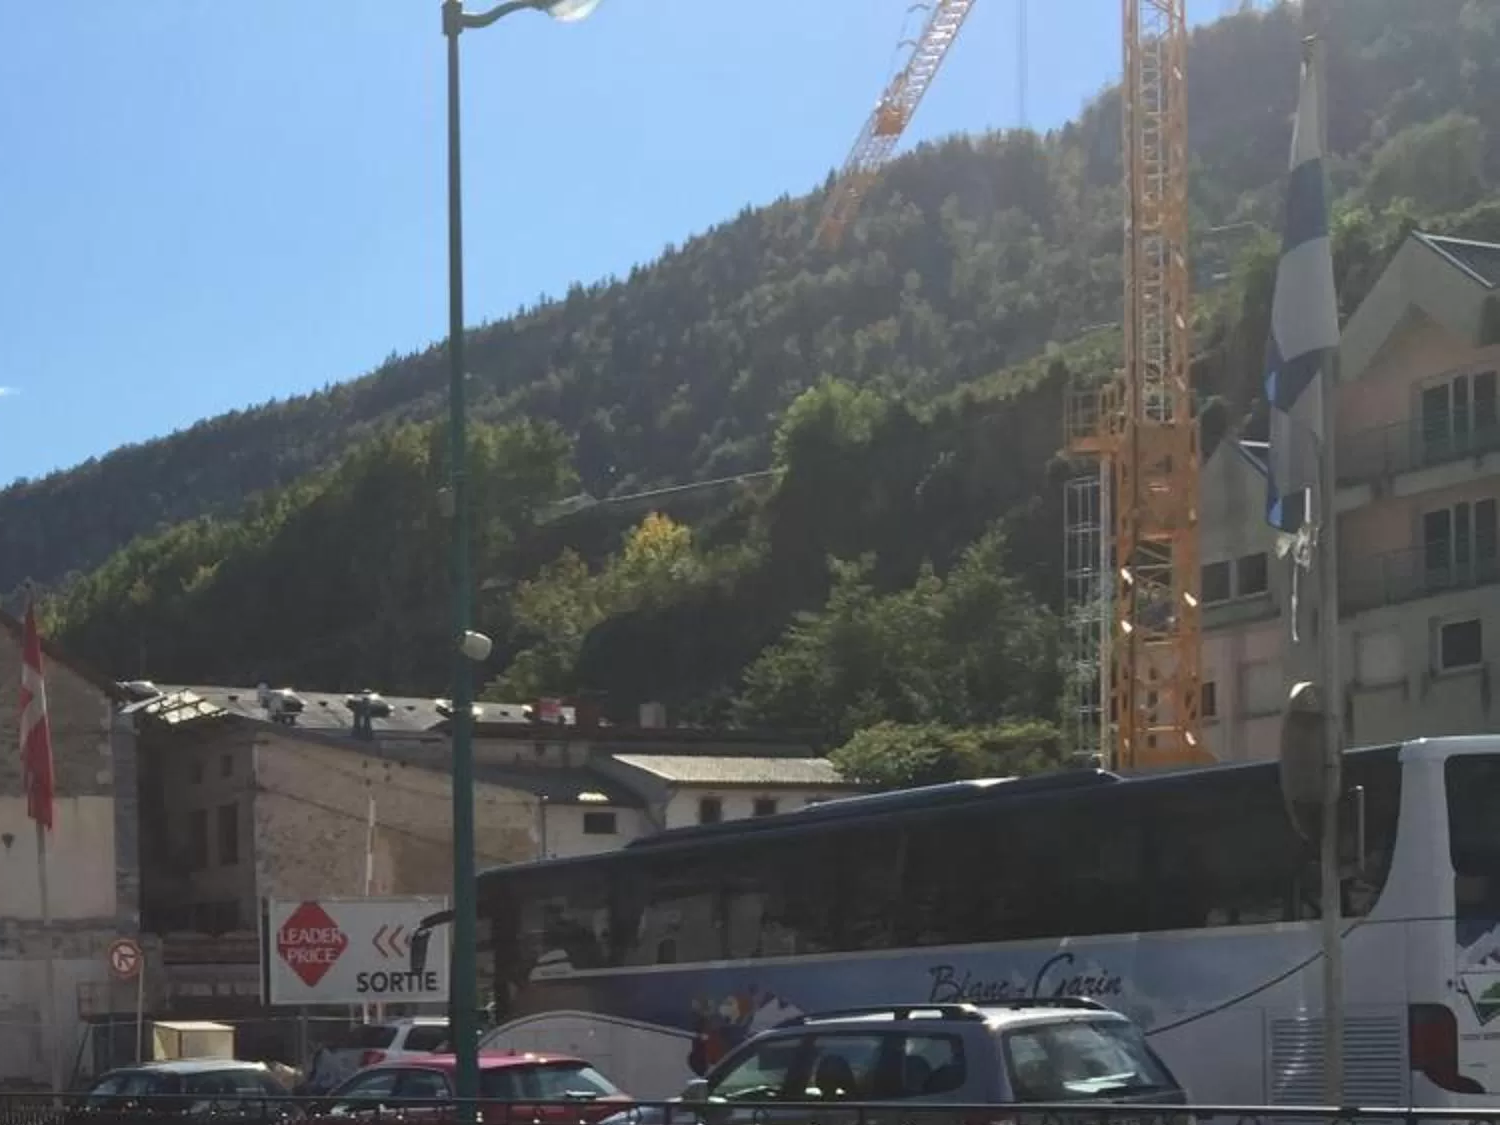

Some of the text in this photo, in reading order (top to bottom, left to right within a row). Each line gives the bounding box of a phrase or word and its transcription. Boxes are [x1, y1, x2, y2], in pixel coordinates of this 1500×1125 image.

[279, 928, 343, 945] LEADER
[286, 948, 338, 963] PRICE
[356, 972, 437, 993] SORTIE
